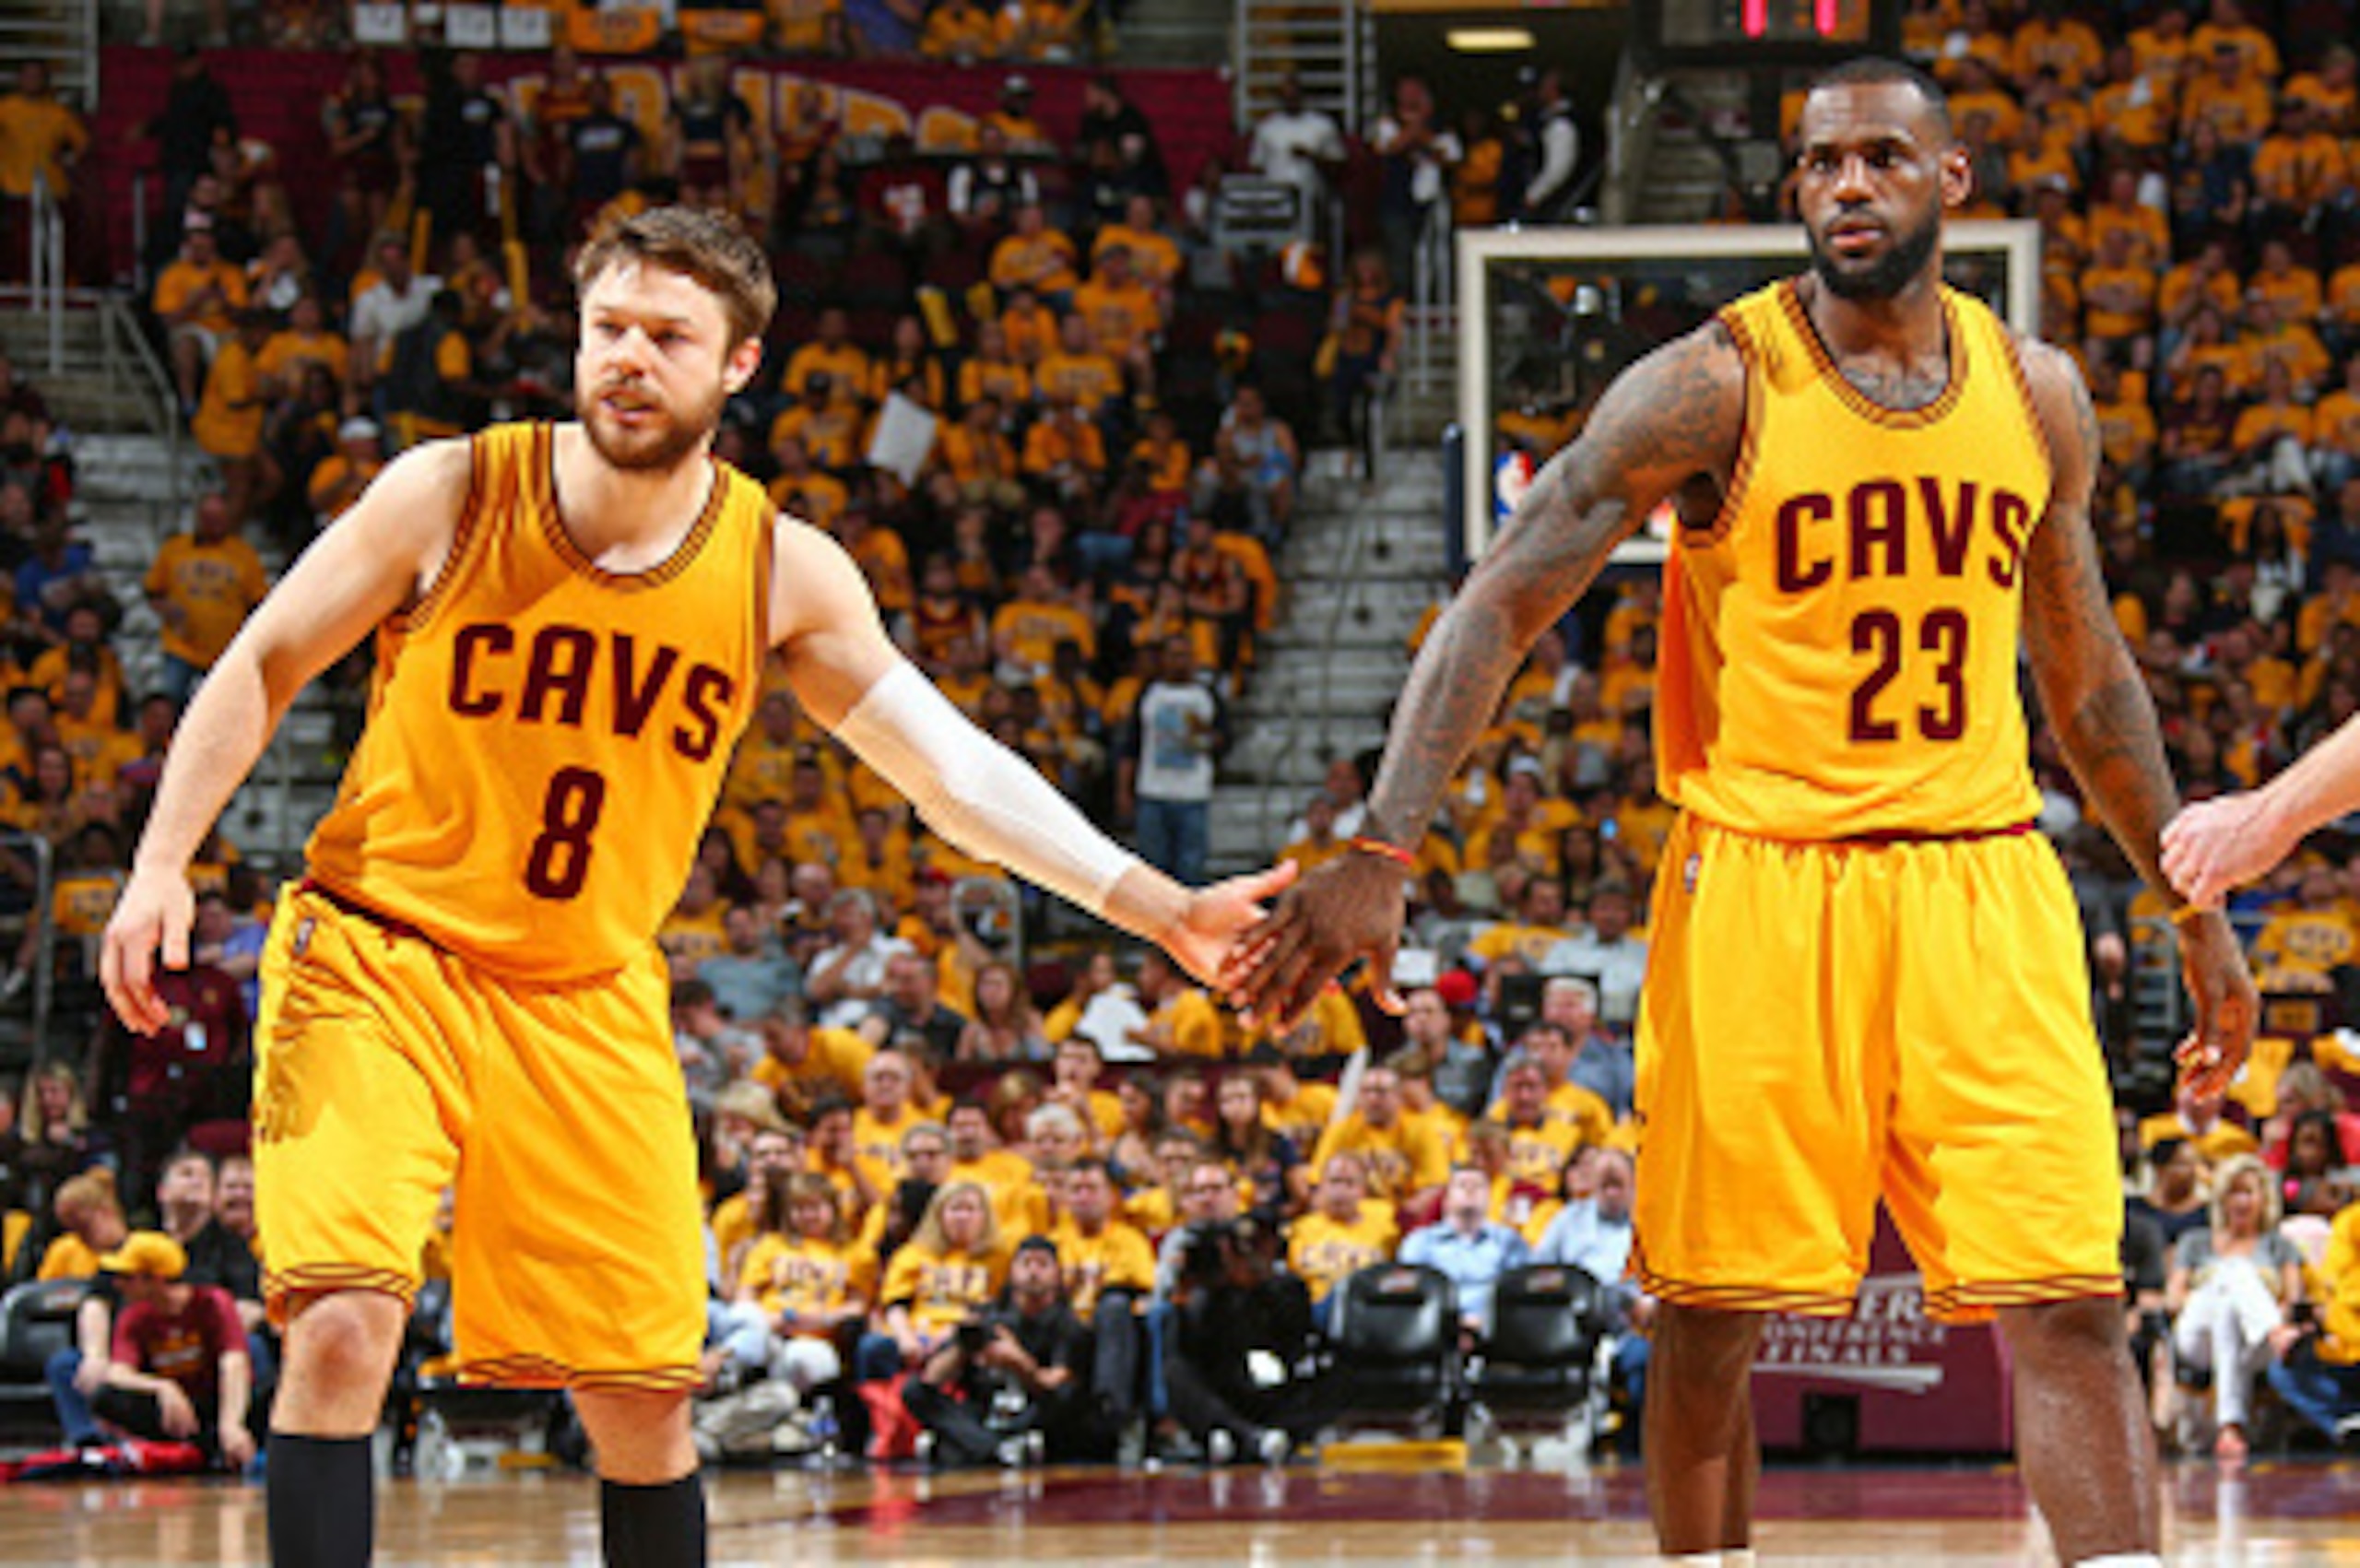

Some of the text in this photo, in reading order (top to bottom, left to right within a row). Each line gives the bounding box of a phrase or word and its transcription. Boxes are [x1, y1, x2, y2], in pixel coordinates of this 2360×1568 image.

[1776, 477, 2028, 593] CAVS
[449, 623, 734, 762] CAVS
[1849, 606, 1968, 742] 23
[525, 766, 605, 900] 8
[1762, 1319, 1947, 1346] ONFERENCE
